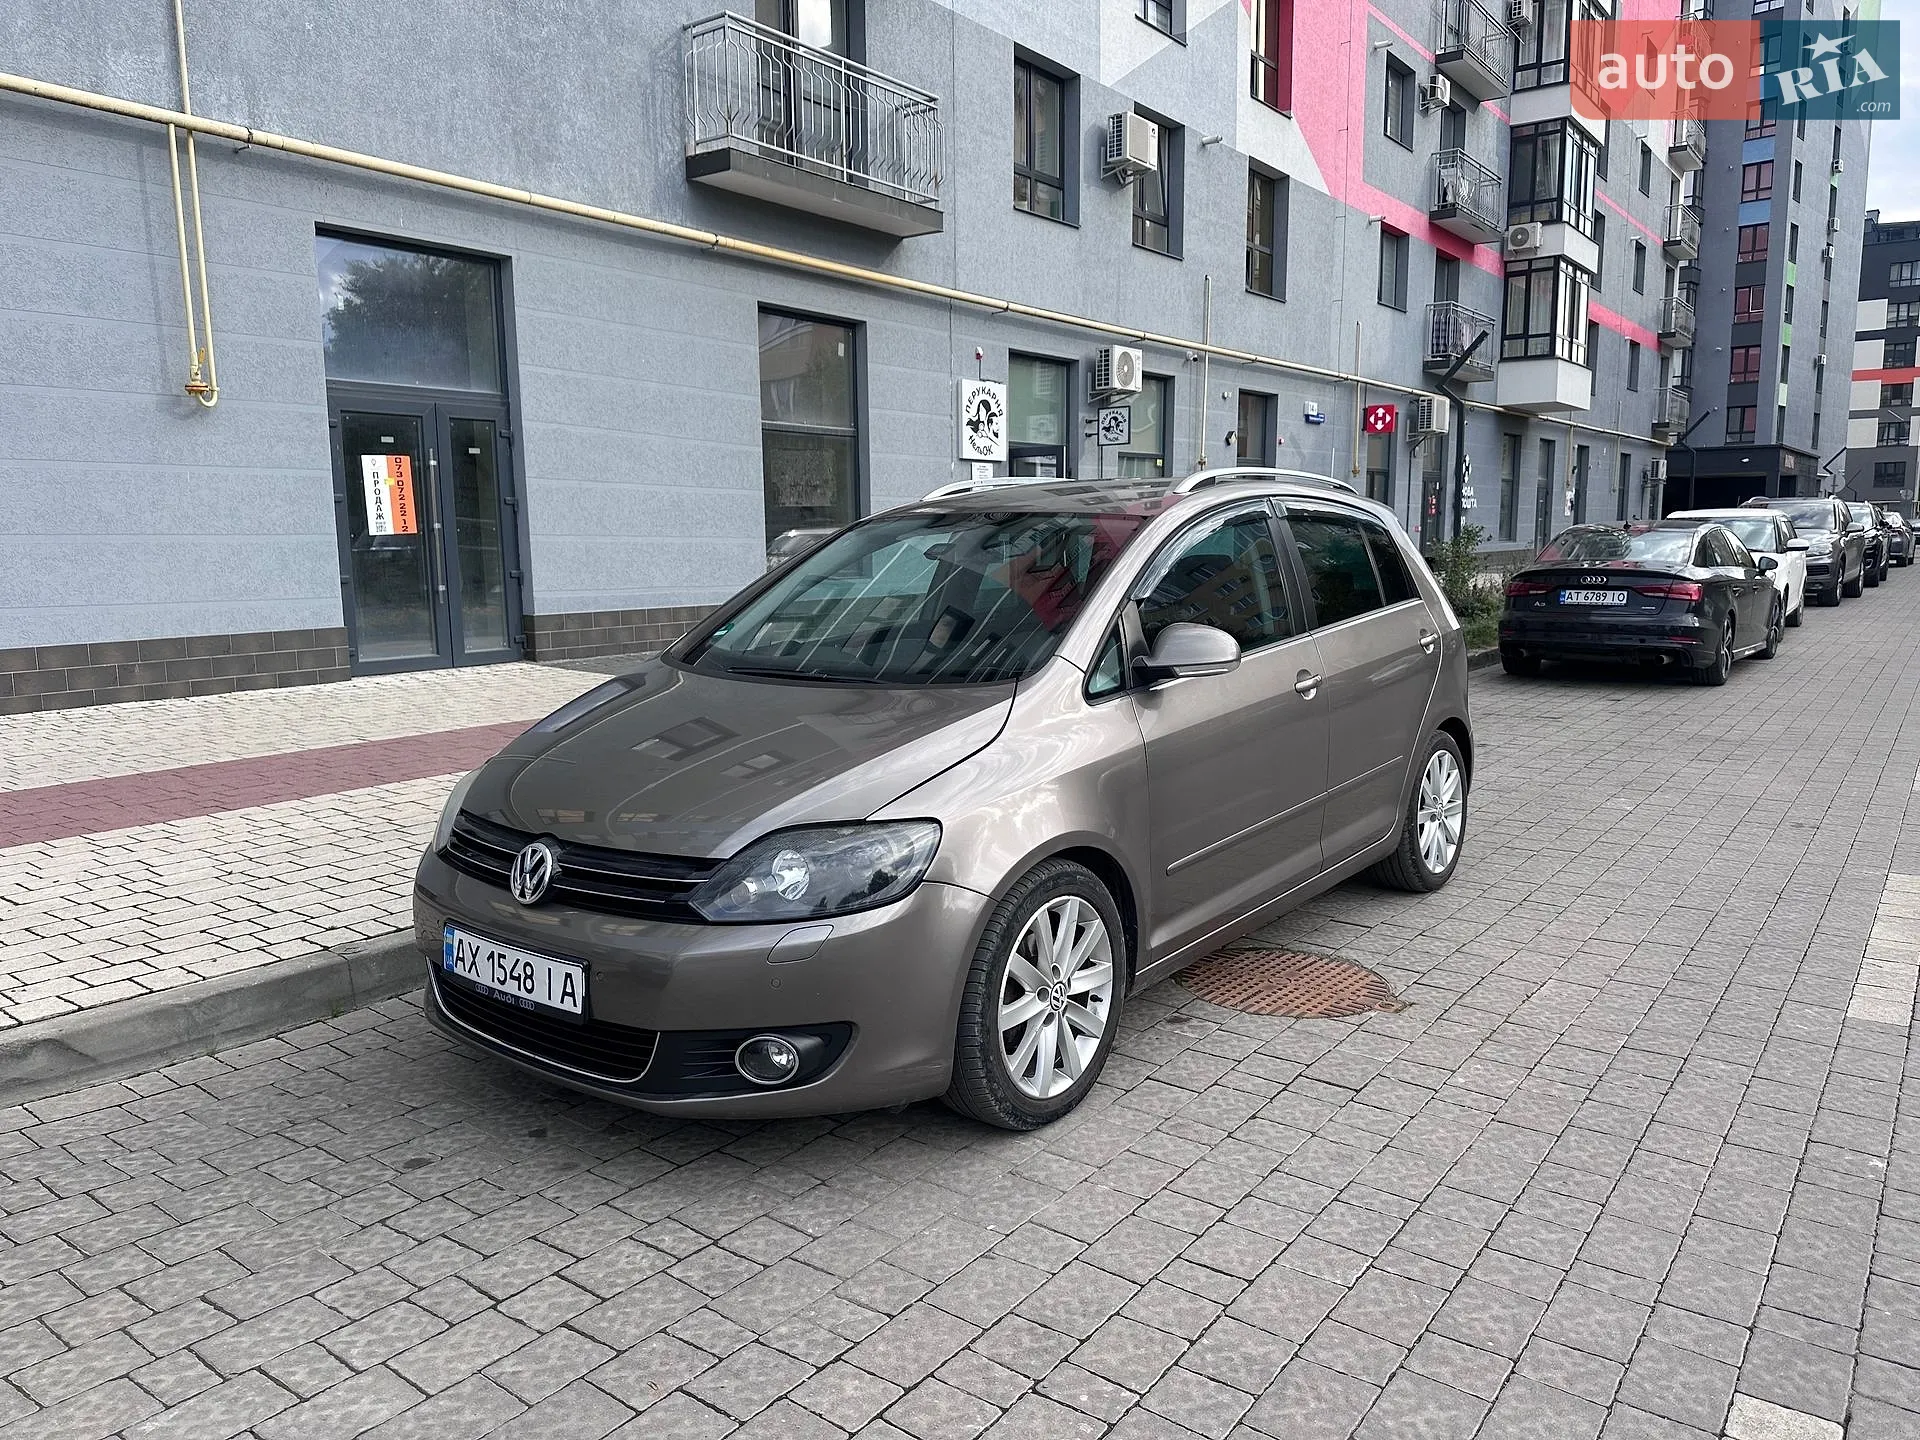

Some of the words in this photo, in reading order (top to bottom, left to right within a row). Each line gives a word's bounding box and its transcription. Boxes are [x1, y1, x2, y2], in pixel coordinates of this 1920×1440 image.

[965, 385, 1004, 417] ПЕРУКАРНЯ
[1101, 410, 1127, 425] ПЕРУКАРНЯ
[372, 471, 385, 520] ПРОДАЖ
[1566, 591, 1582, 601] AT
[1583, 591, 1608, 602] 6789
[1611, 592, 1626, 602] IO
[454, 938, 481, 978] AX
[486, 950, 535, 995] 1548
[547, 967, 578, 1008] IA
[493, 991, 515, 1005] Audi
